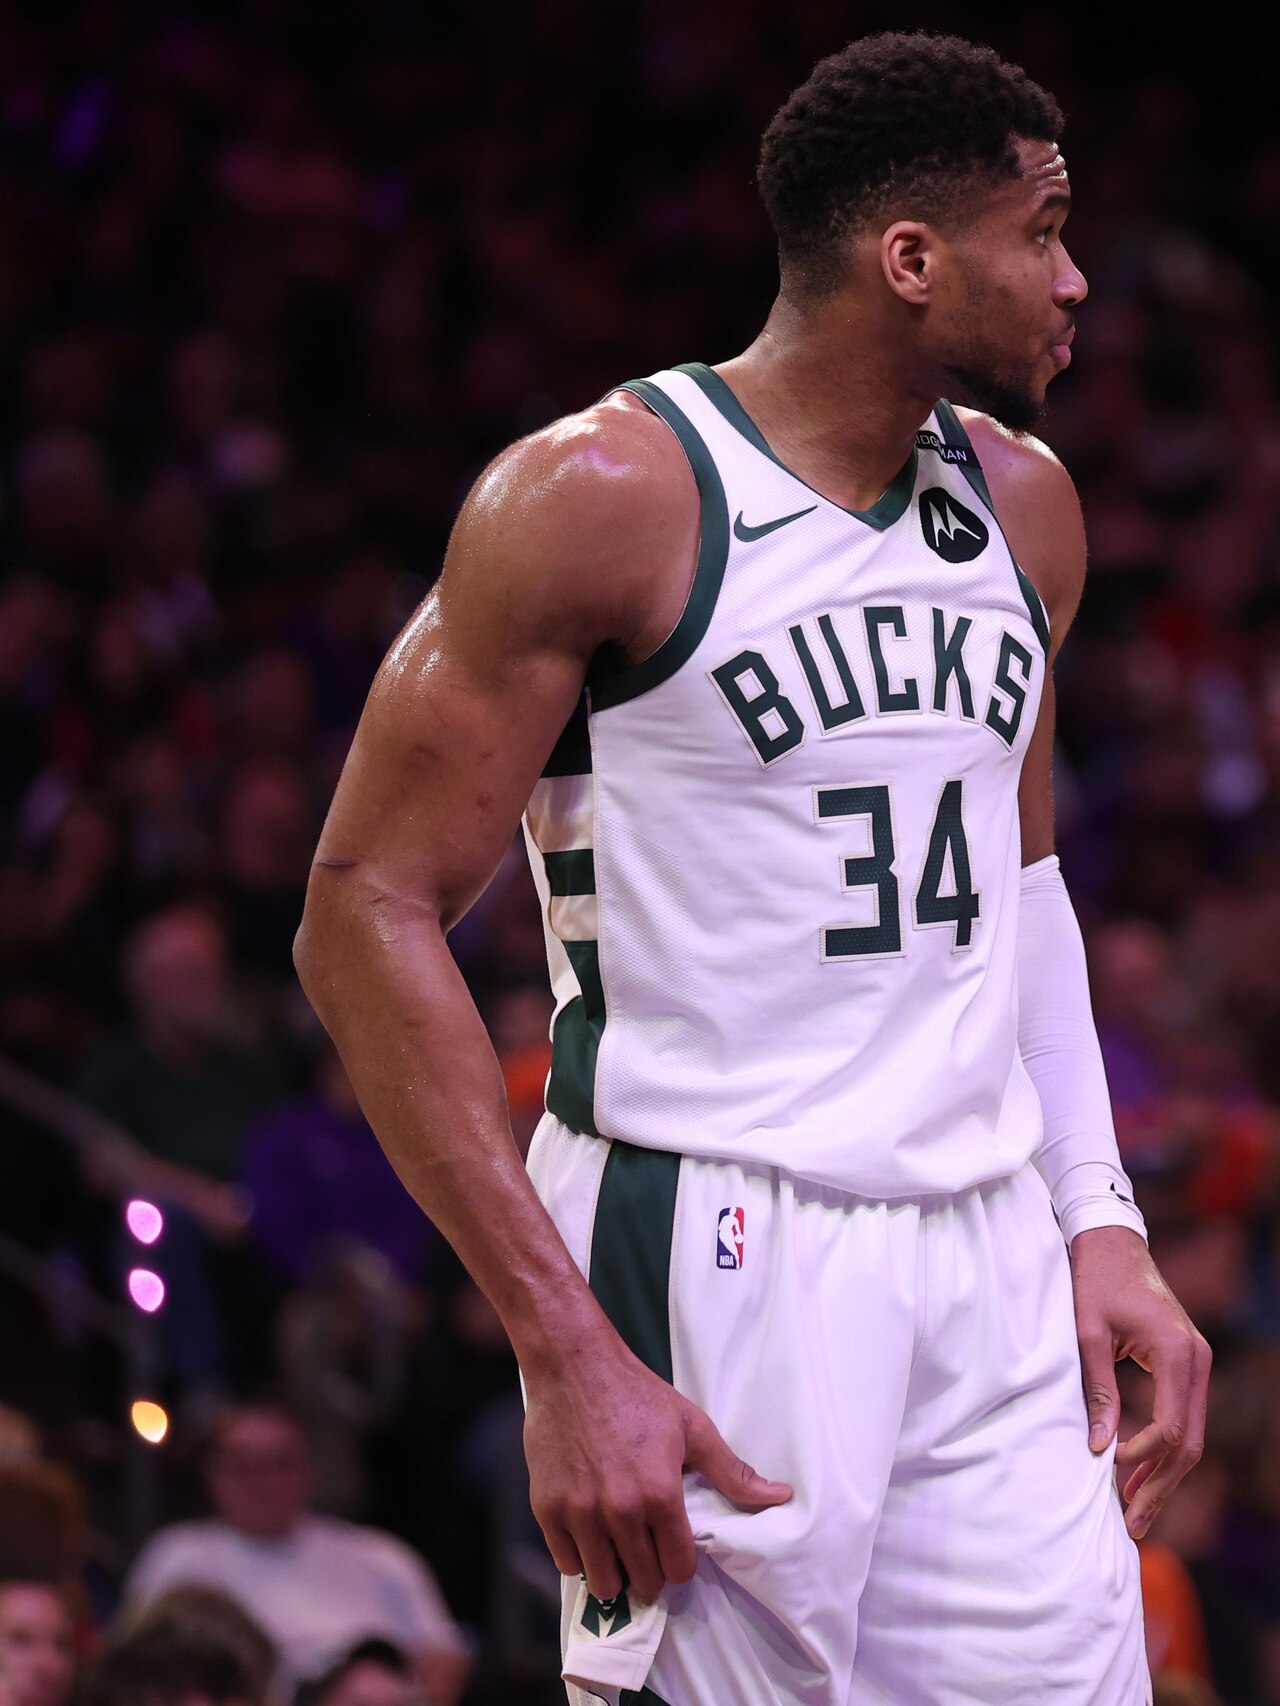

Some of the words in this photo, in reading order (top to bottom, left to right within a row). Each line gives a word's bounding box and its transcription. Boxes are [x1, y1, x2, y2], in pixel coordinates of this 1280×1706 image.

[706, 603, 1034, 769] BUCKS
[811, 775, 984, 964] 34
[719, 1254, 735, 1267] NBA
